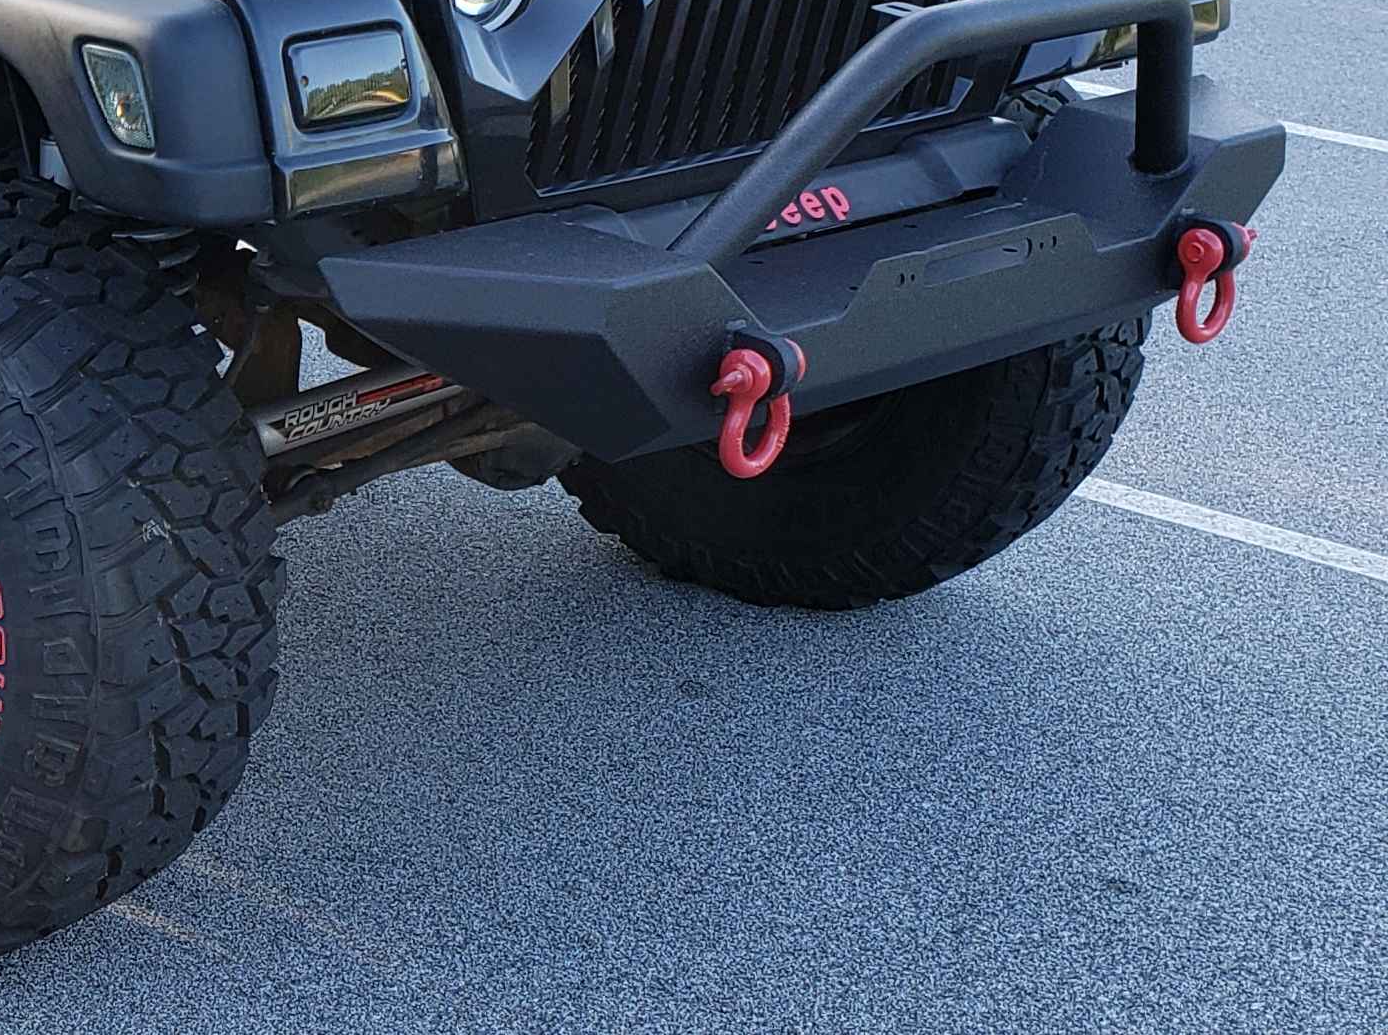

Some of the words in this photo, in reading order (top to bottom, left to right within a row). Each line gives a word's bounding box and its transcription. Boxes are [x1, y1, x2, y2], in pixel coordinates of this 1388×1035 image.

[765, 186, 850, 231] eep
[284, 390, 358, 429] ROUGH
[284, 397, 391, 443] COUNTRY
